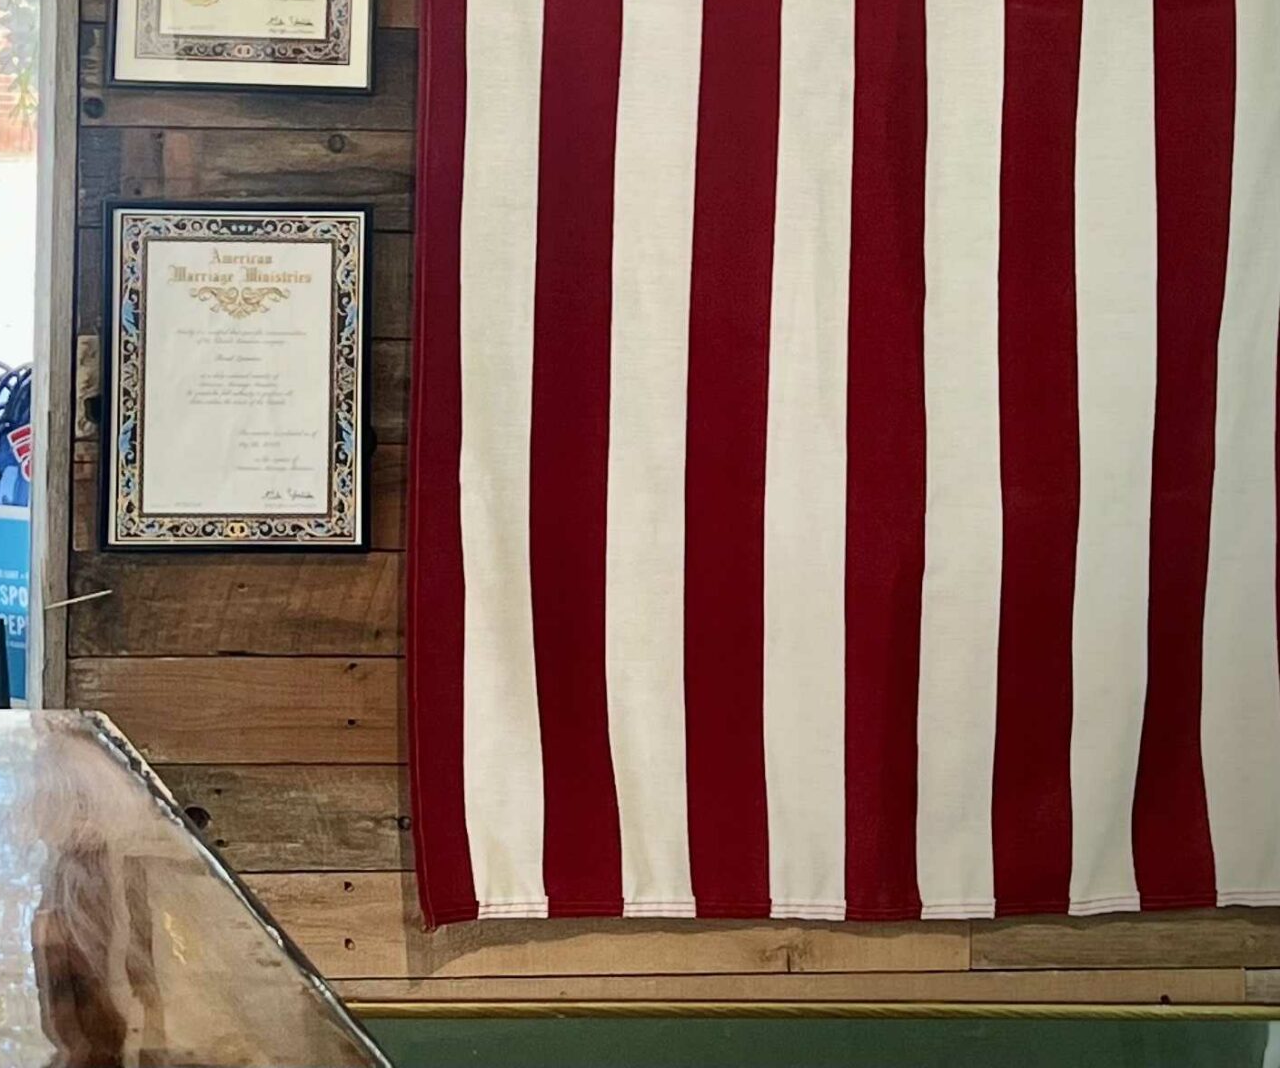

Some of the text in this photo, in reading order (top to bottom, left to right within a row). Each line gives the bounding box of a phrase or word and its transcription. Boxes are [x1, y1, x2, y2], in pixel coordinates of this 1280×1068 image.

[210, 247, 273, 264] American
[168, 264, 312, 284] Marriage Ministries
